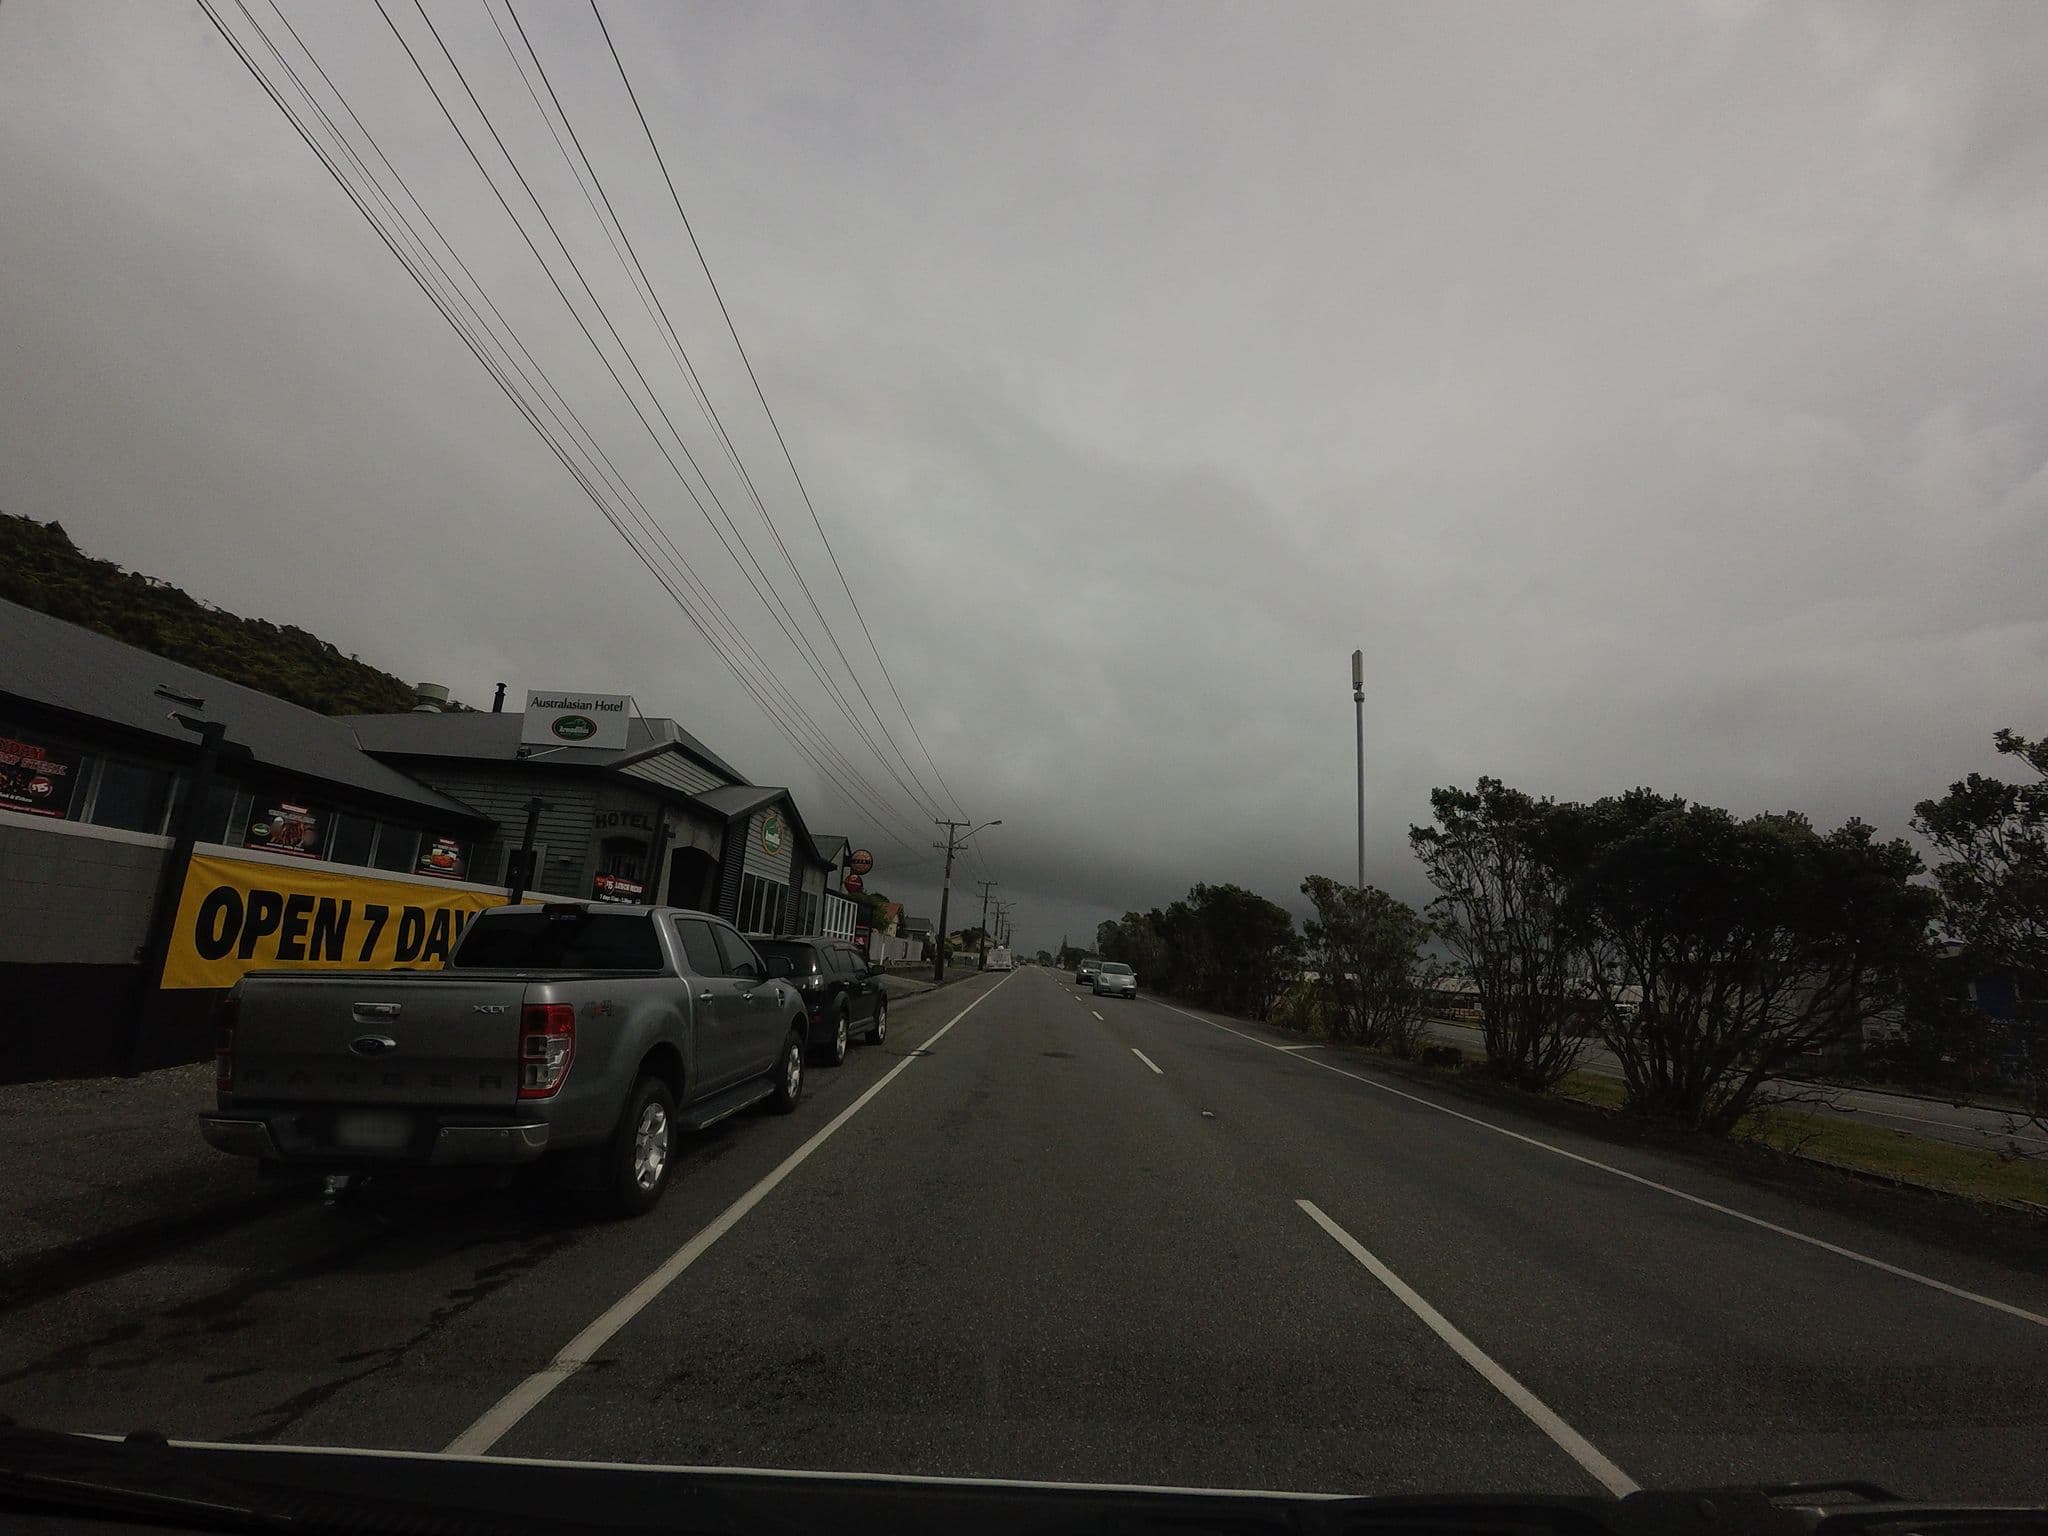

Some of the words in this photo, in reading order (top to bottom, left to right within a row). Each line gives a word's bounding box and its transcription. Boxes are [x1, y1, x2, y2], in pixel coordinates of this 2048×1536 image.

[531, 697, 592, 711] Australasian
[595, 700, 623, 712] Hotel
[595, 812, 653, 831] HOTEL
[195, 885, 352, 961] OPEN
[358, 904, 389, 962] 7
[472, 1004, 512, 1014] XLT
[243, 1071, 502, 1090] RANGER
